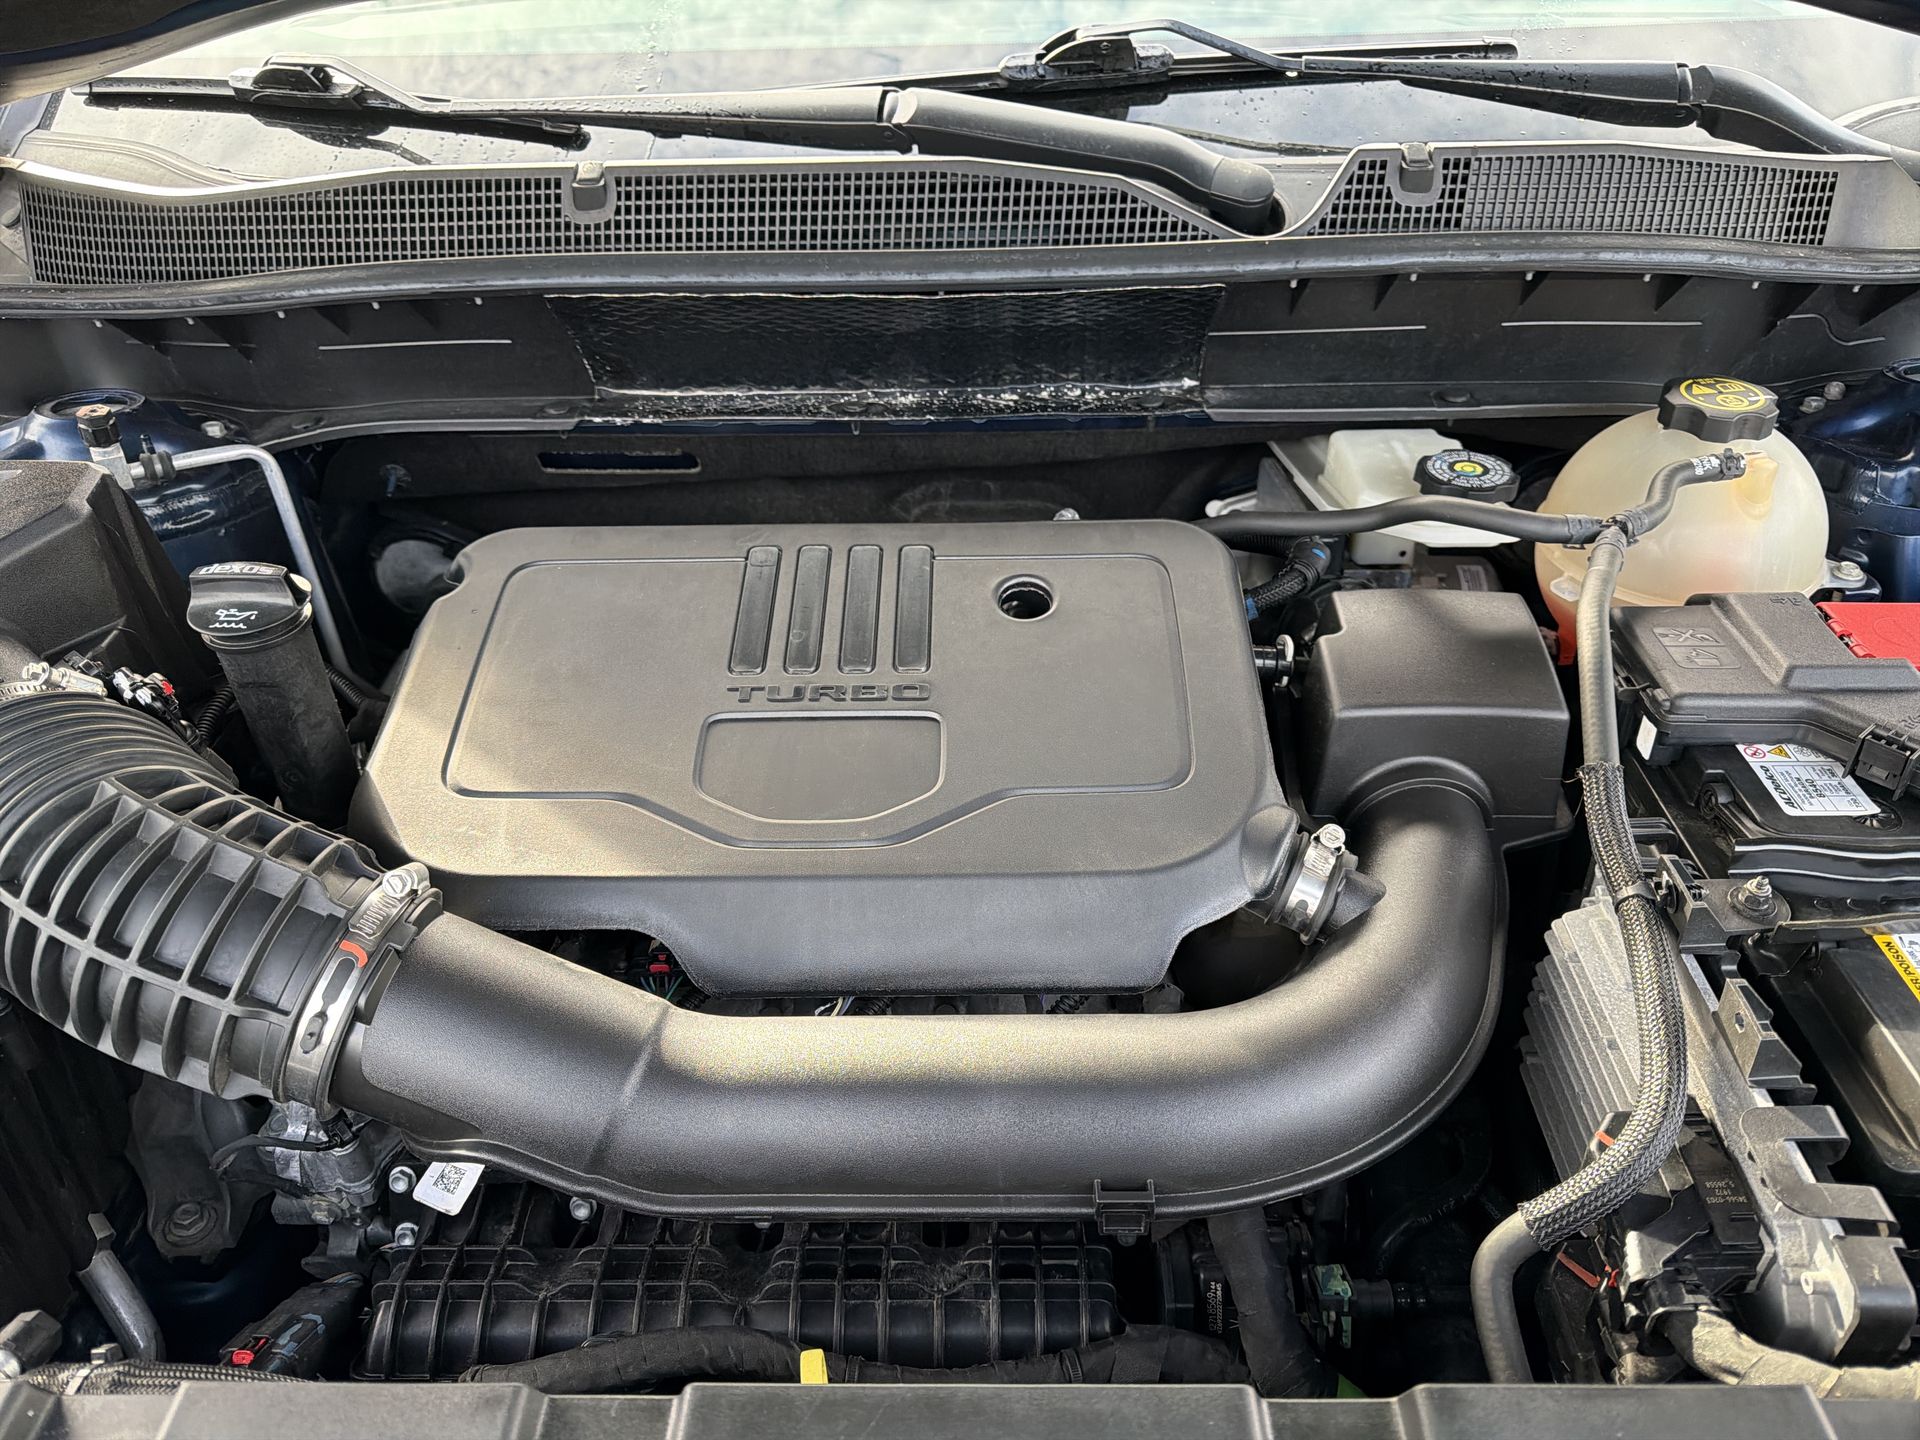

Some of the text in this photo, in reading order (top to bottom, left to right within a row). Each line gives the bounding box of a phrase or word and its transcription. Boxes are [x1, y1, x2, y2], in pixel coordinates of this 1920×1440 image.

[198, 563, 274, 575] dexos
[726, 683, 931, 703] TURBO
[1759, 765, 1798, 810] ACDelco
[1804, 779, 1826, 798] 8540
[1881, 941, 1920, 994] ER/POISON
